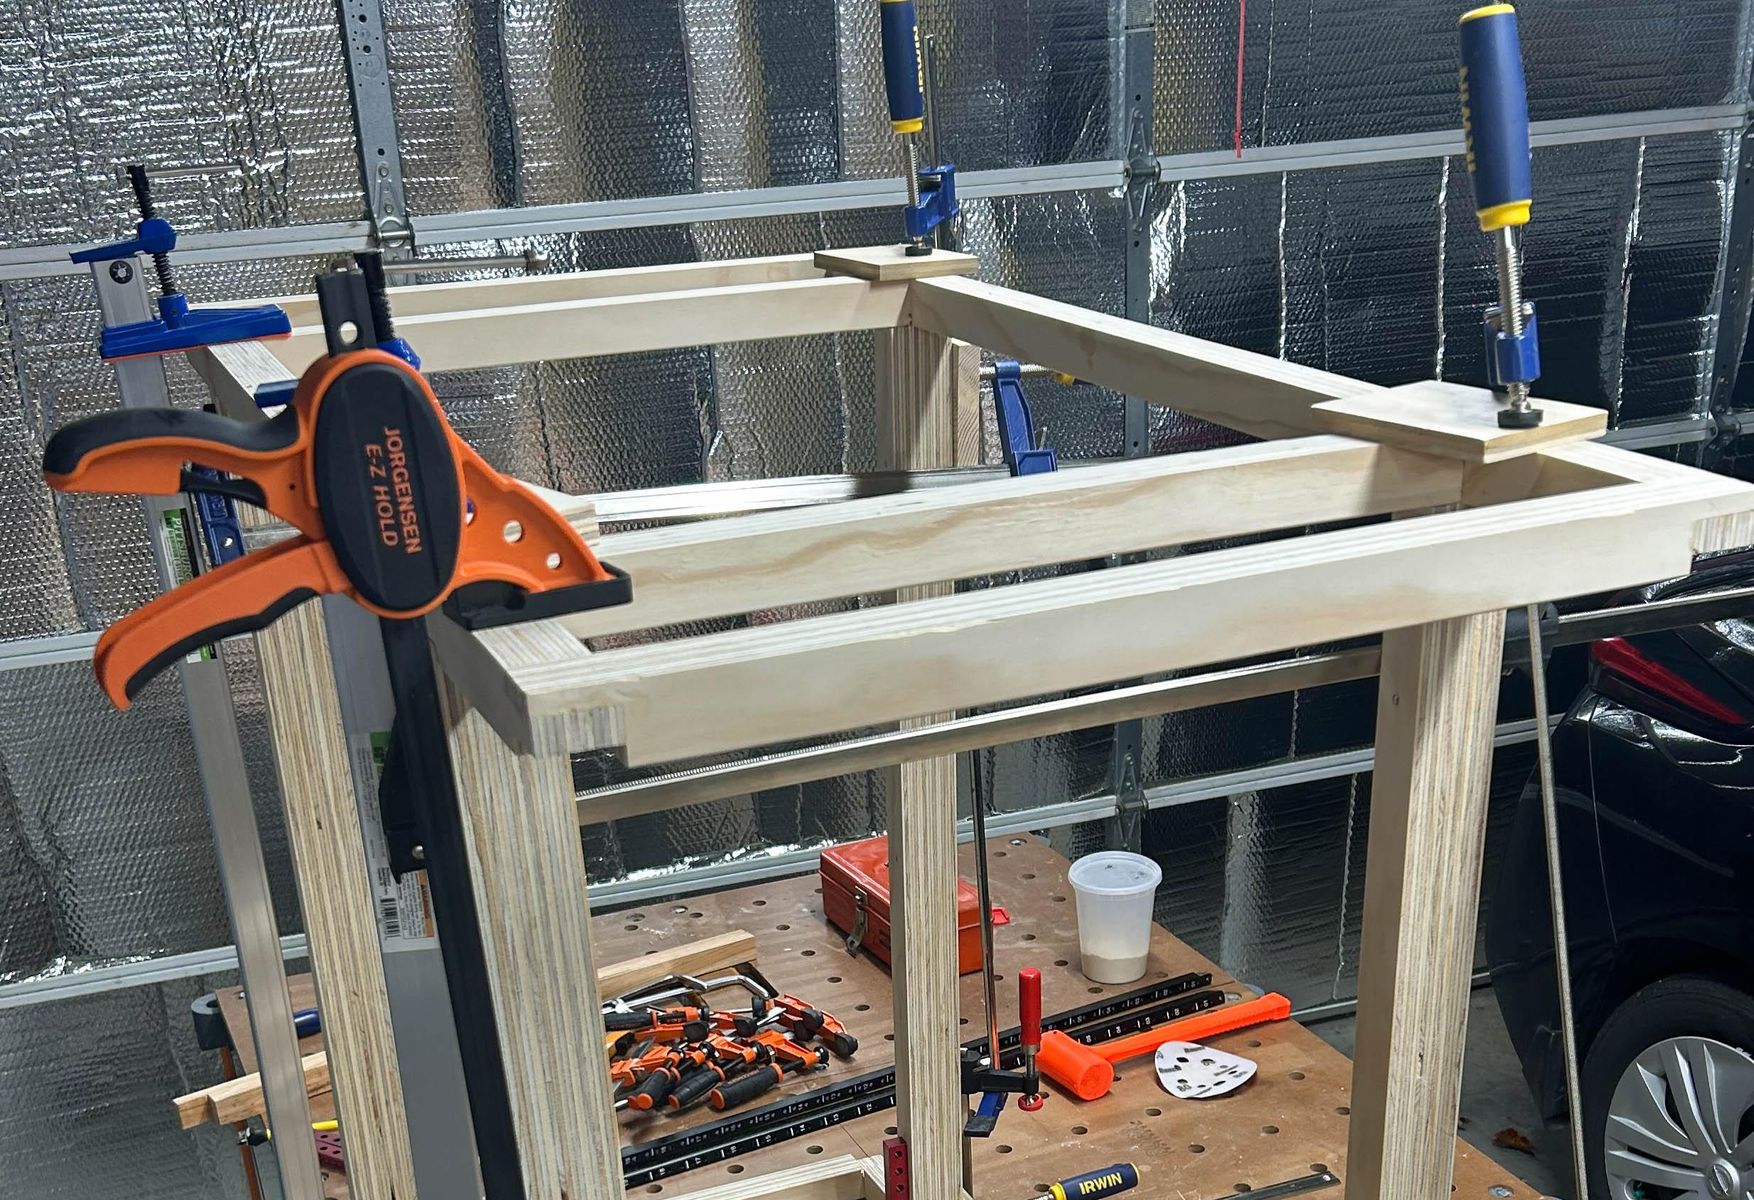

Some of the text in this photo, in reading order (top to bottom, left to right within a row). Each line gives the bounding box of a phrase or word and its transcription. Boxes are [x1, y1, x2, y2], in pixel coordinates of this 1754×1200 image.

[366, 443, 399, 547] E-Z HOLD
[384, 425, 422, 554] JORGENSEN
[172, 516, 195, 580] PITTSBURG
[1079, 1172, 1123, 1195] IRWIN
